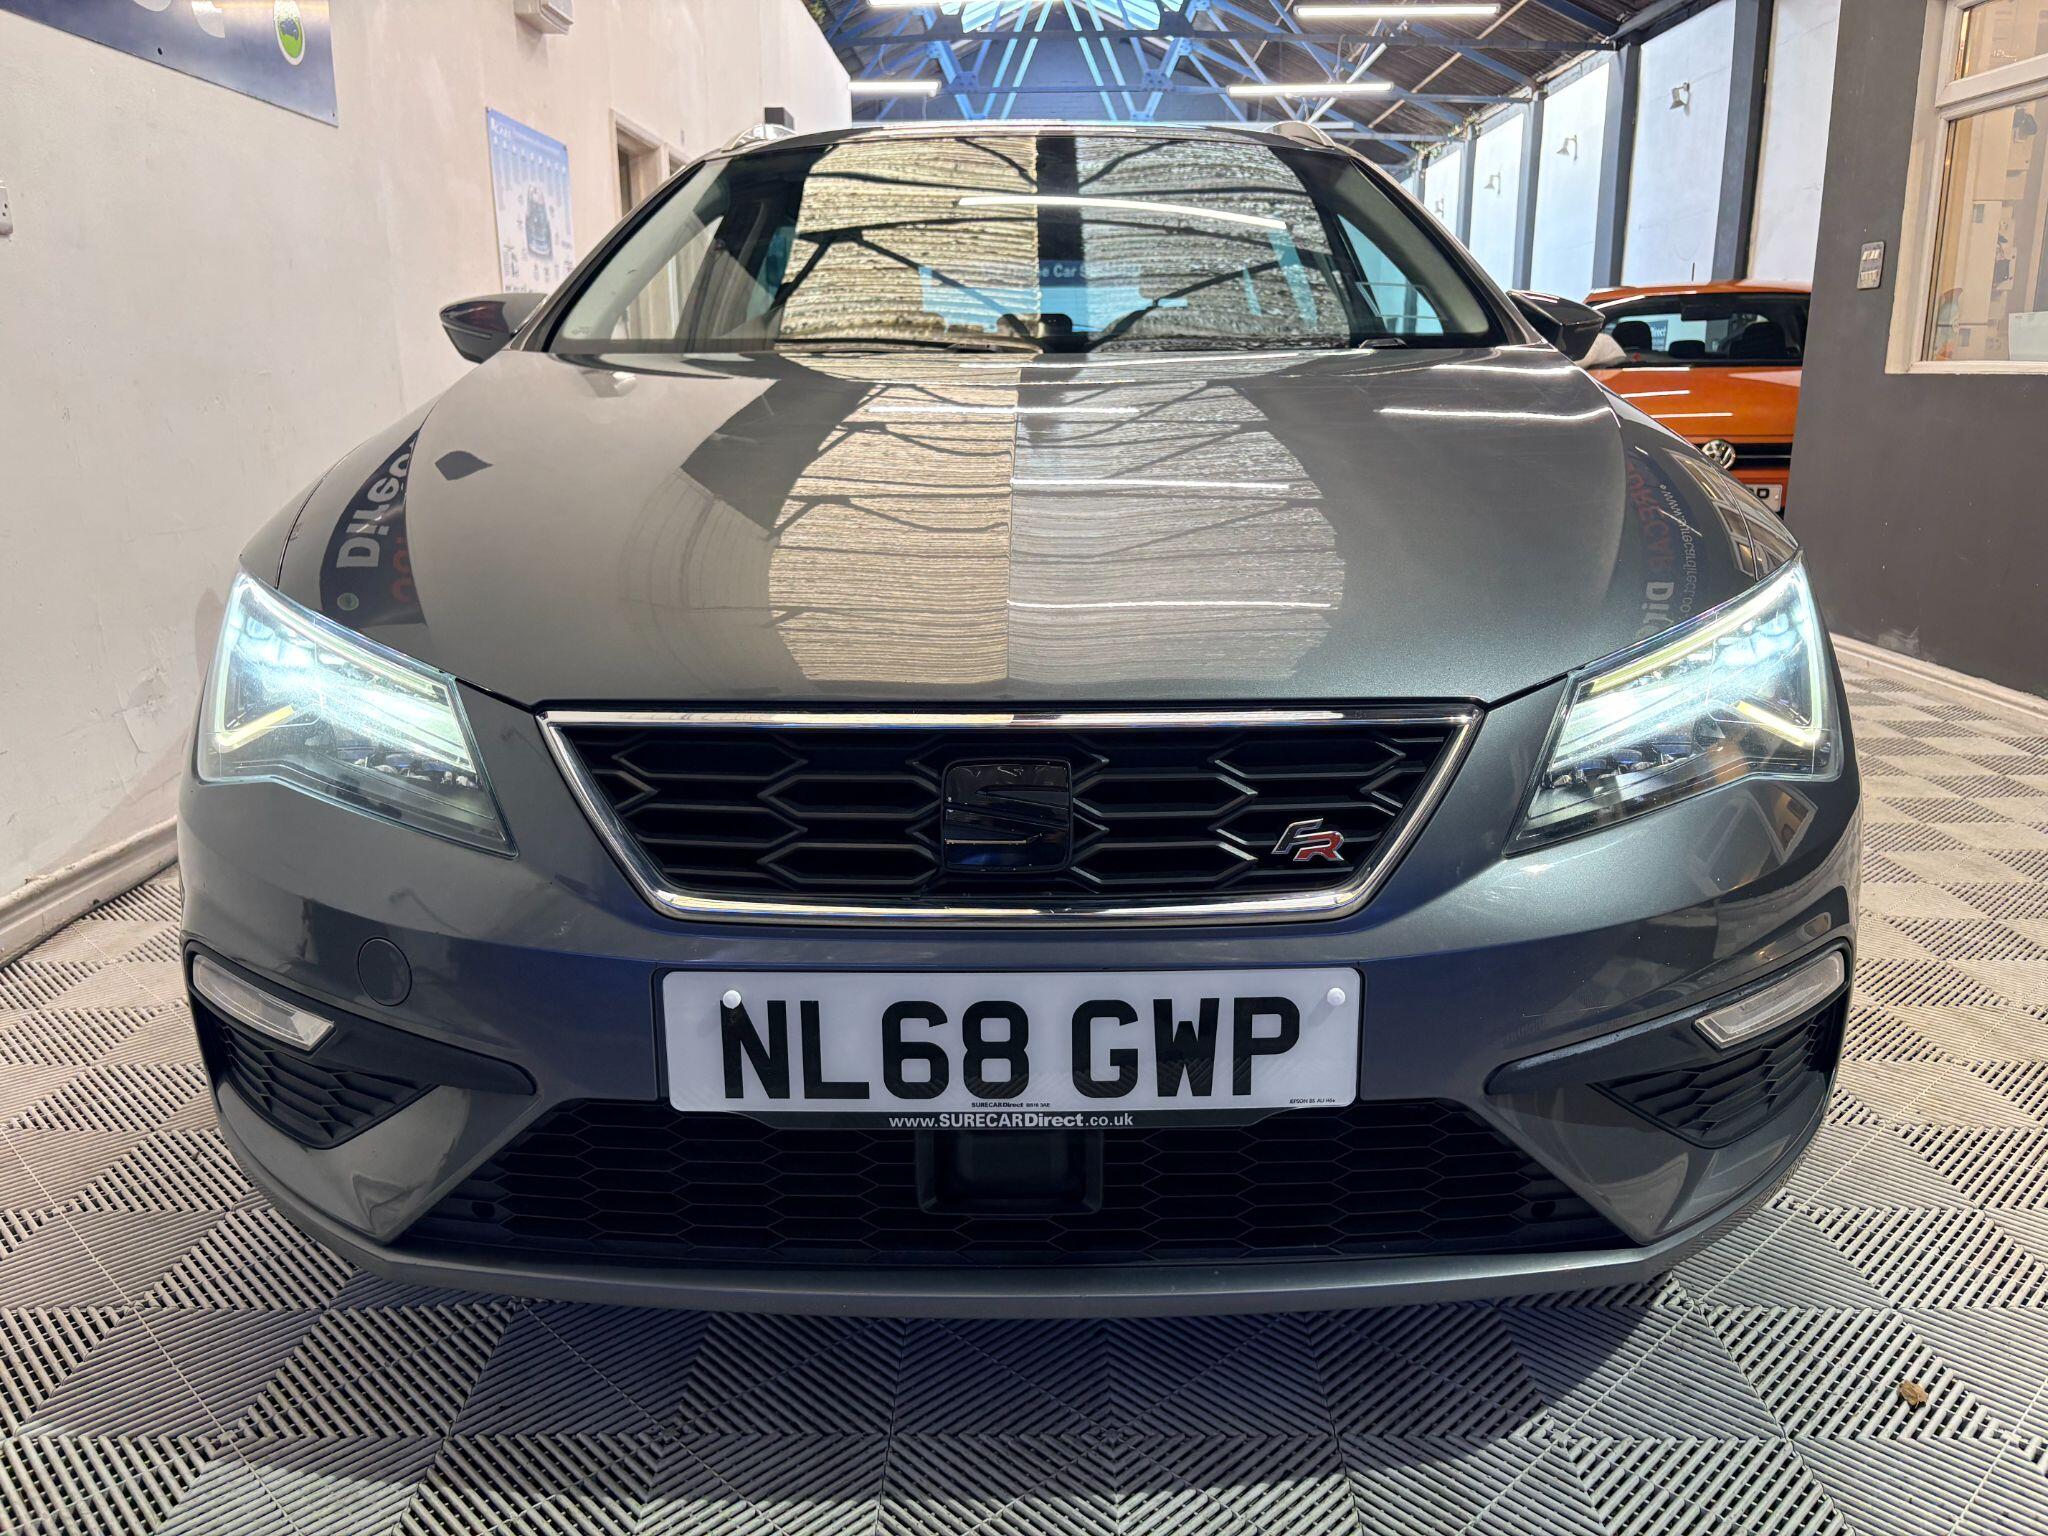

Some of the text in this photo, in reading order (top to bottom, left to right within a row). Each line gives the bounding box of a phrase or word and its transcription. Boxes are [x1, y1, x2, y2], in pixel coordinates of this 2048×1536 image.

[1053, 263, 1077, 278] Car
[1271, 818, 1344, 861] FR
[719, 996, 1301, 1100] NL68 GWP
[888, 1112, 1134, 1128] www.SURECARDirect.co.uk
